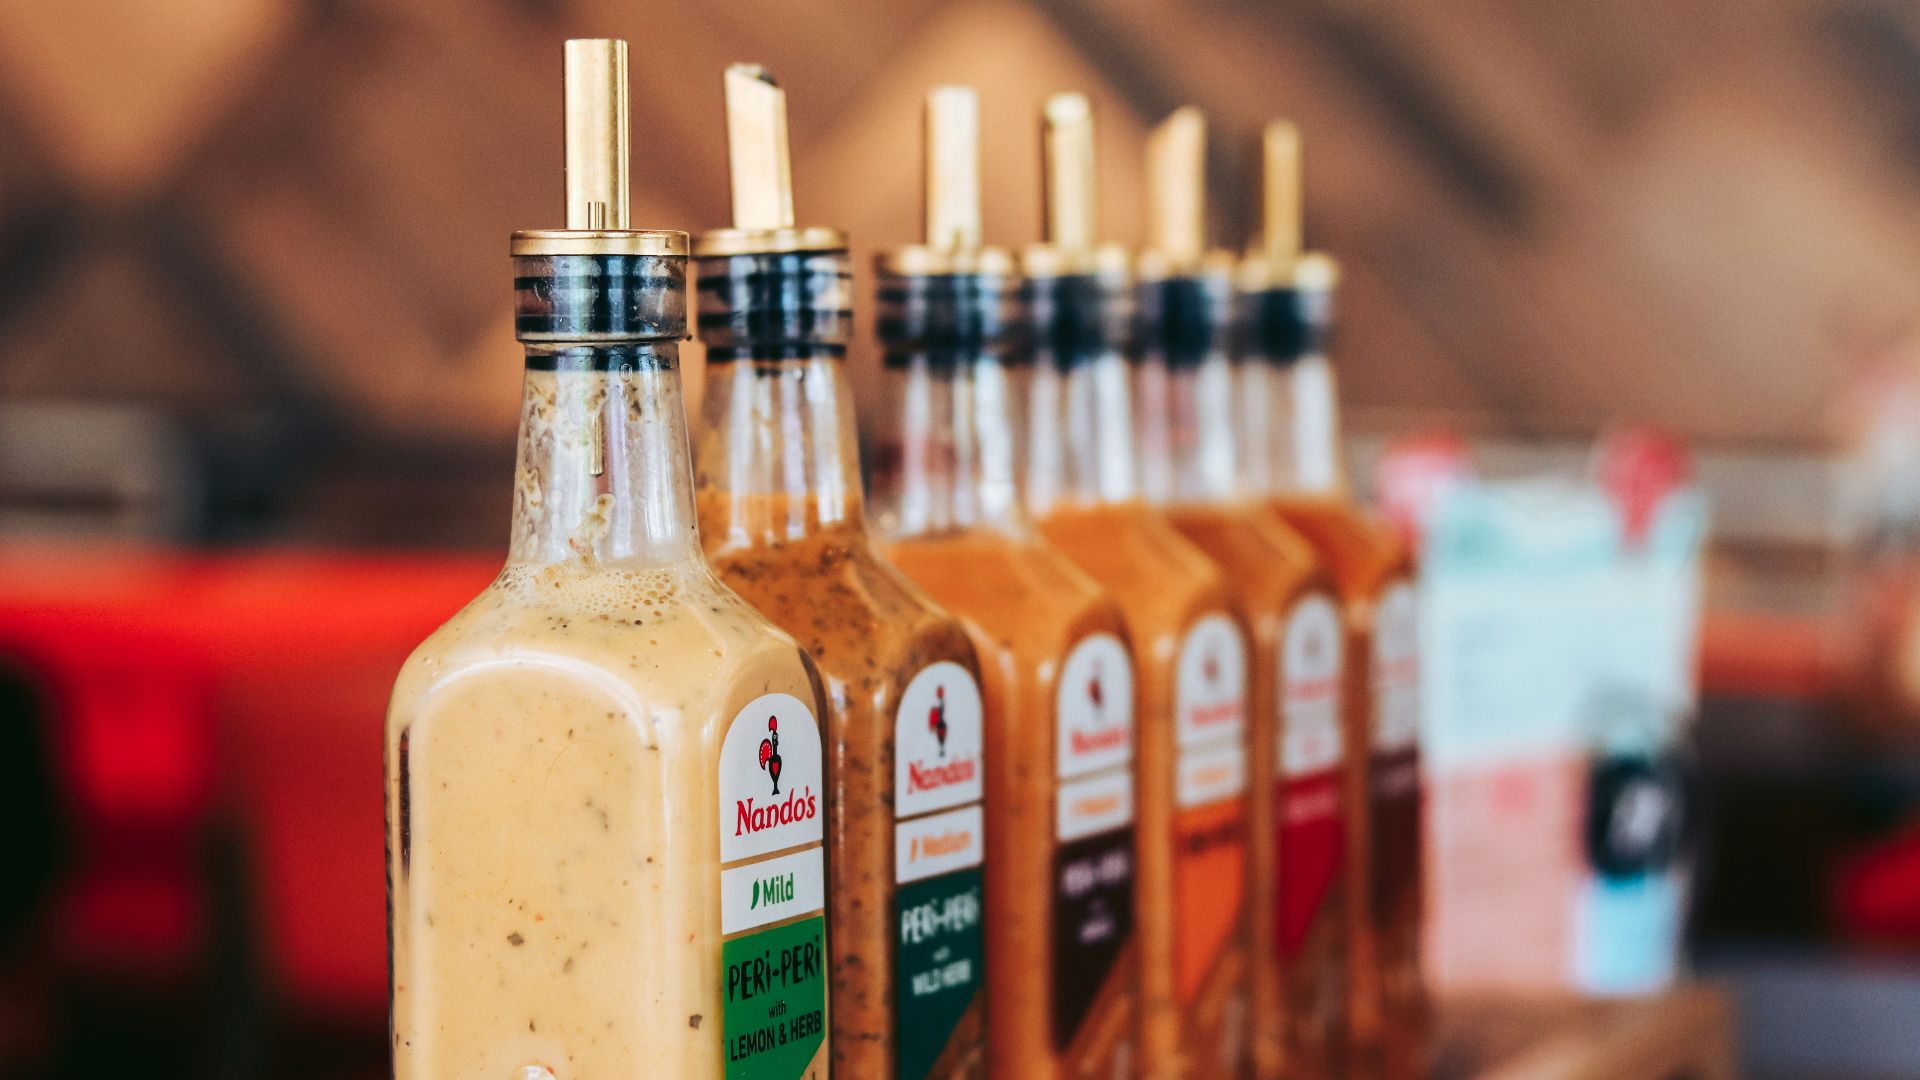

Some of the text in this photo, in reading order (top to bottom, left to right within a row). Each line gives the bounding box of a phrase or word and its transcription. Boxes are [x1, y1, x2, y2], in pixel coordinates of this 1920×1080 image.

[735, 785, 816, 837] Nando's
[763, 872, 794, 908] Mild
[768, 1000, 787, 1019] with
[730, 1009, 822, 1063] LEMON & HERB
